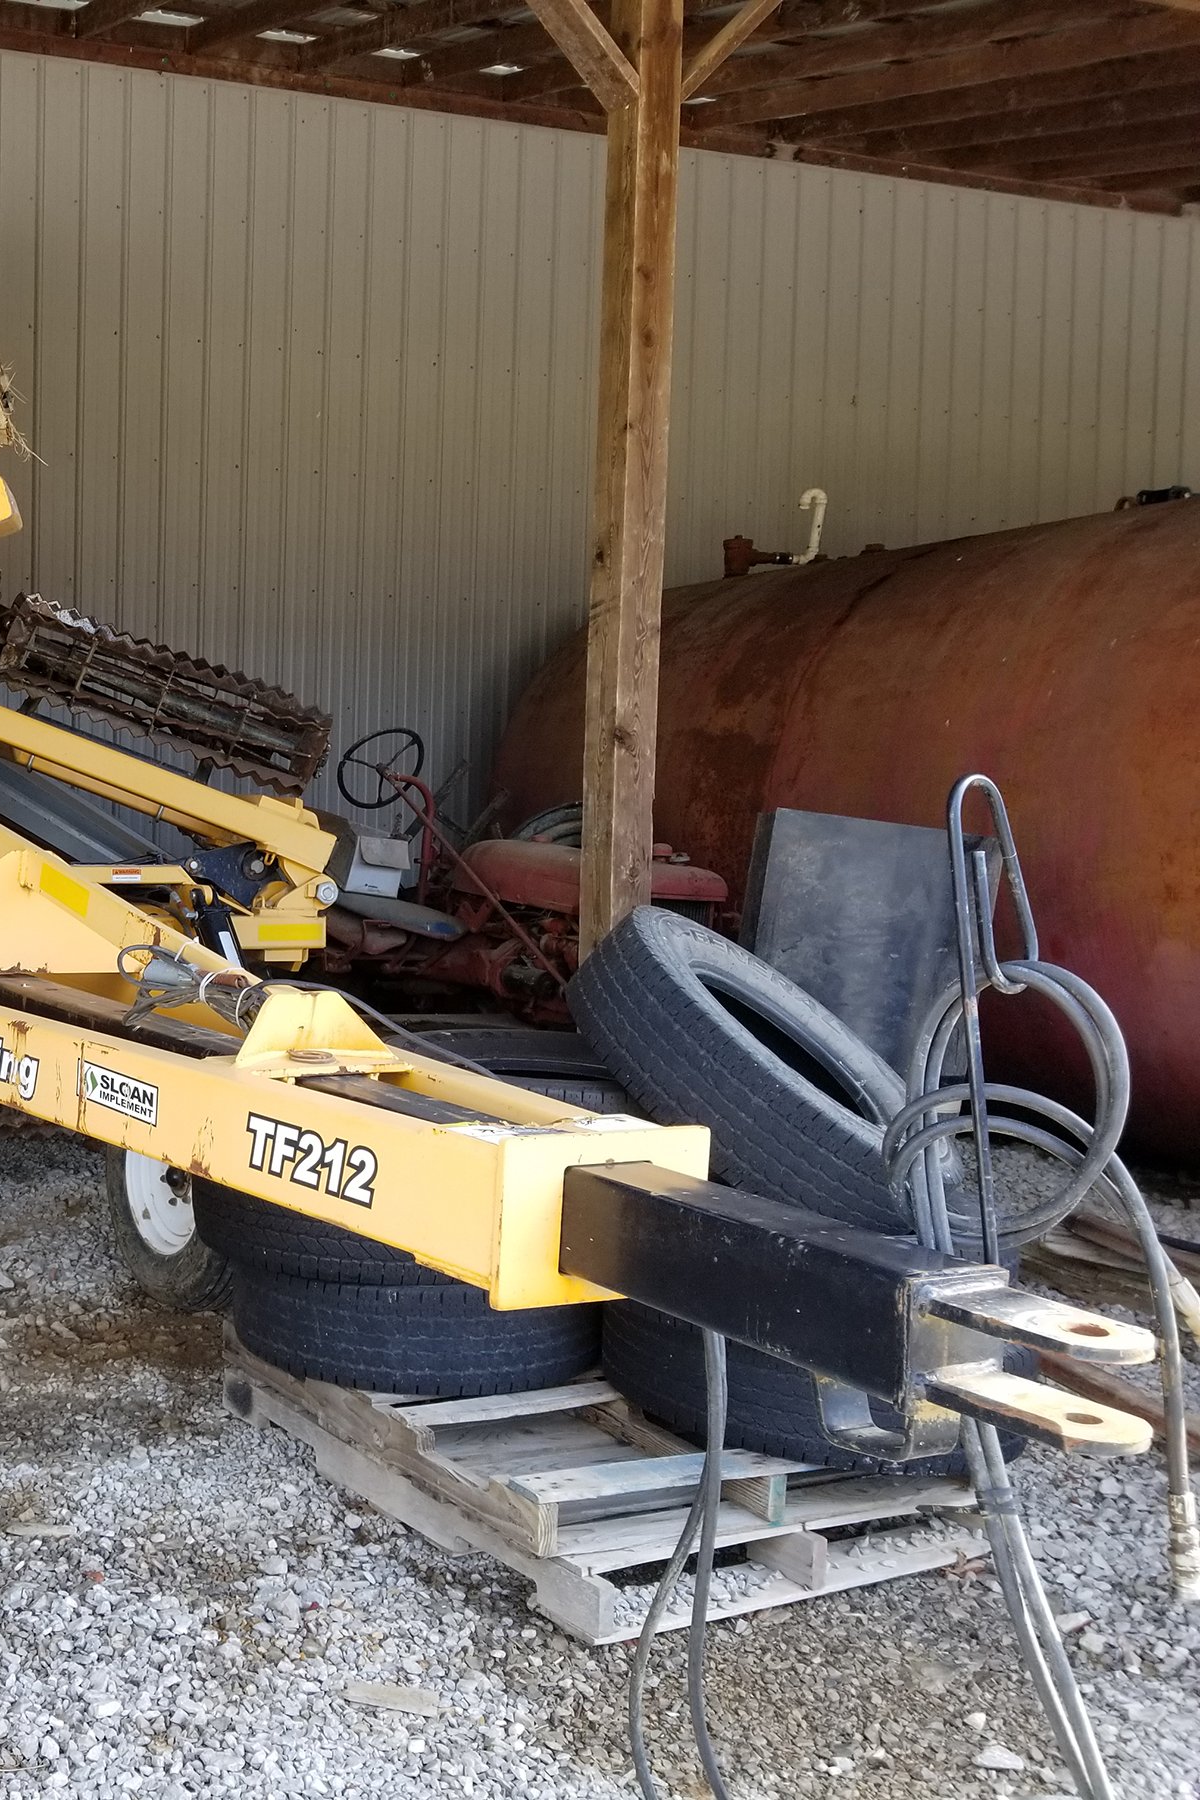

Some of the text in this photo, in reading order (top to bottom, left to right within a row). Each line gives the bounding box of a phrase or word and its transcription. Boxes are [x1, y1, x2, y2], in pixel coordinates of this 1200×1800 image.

[100, 1075, 154, 1108] SLOAN
[100, 1090, 154, 1118] IMPLEMENT
[246, 1111, 378, 1210] TF212
